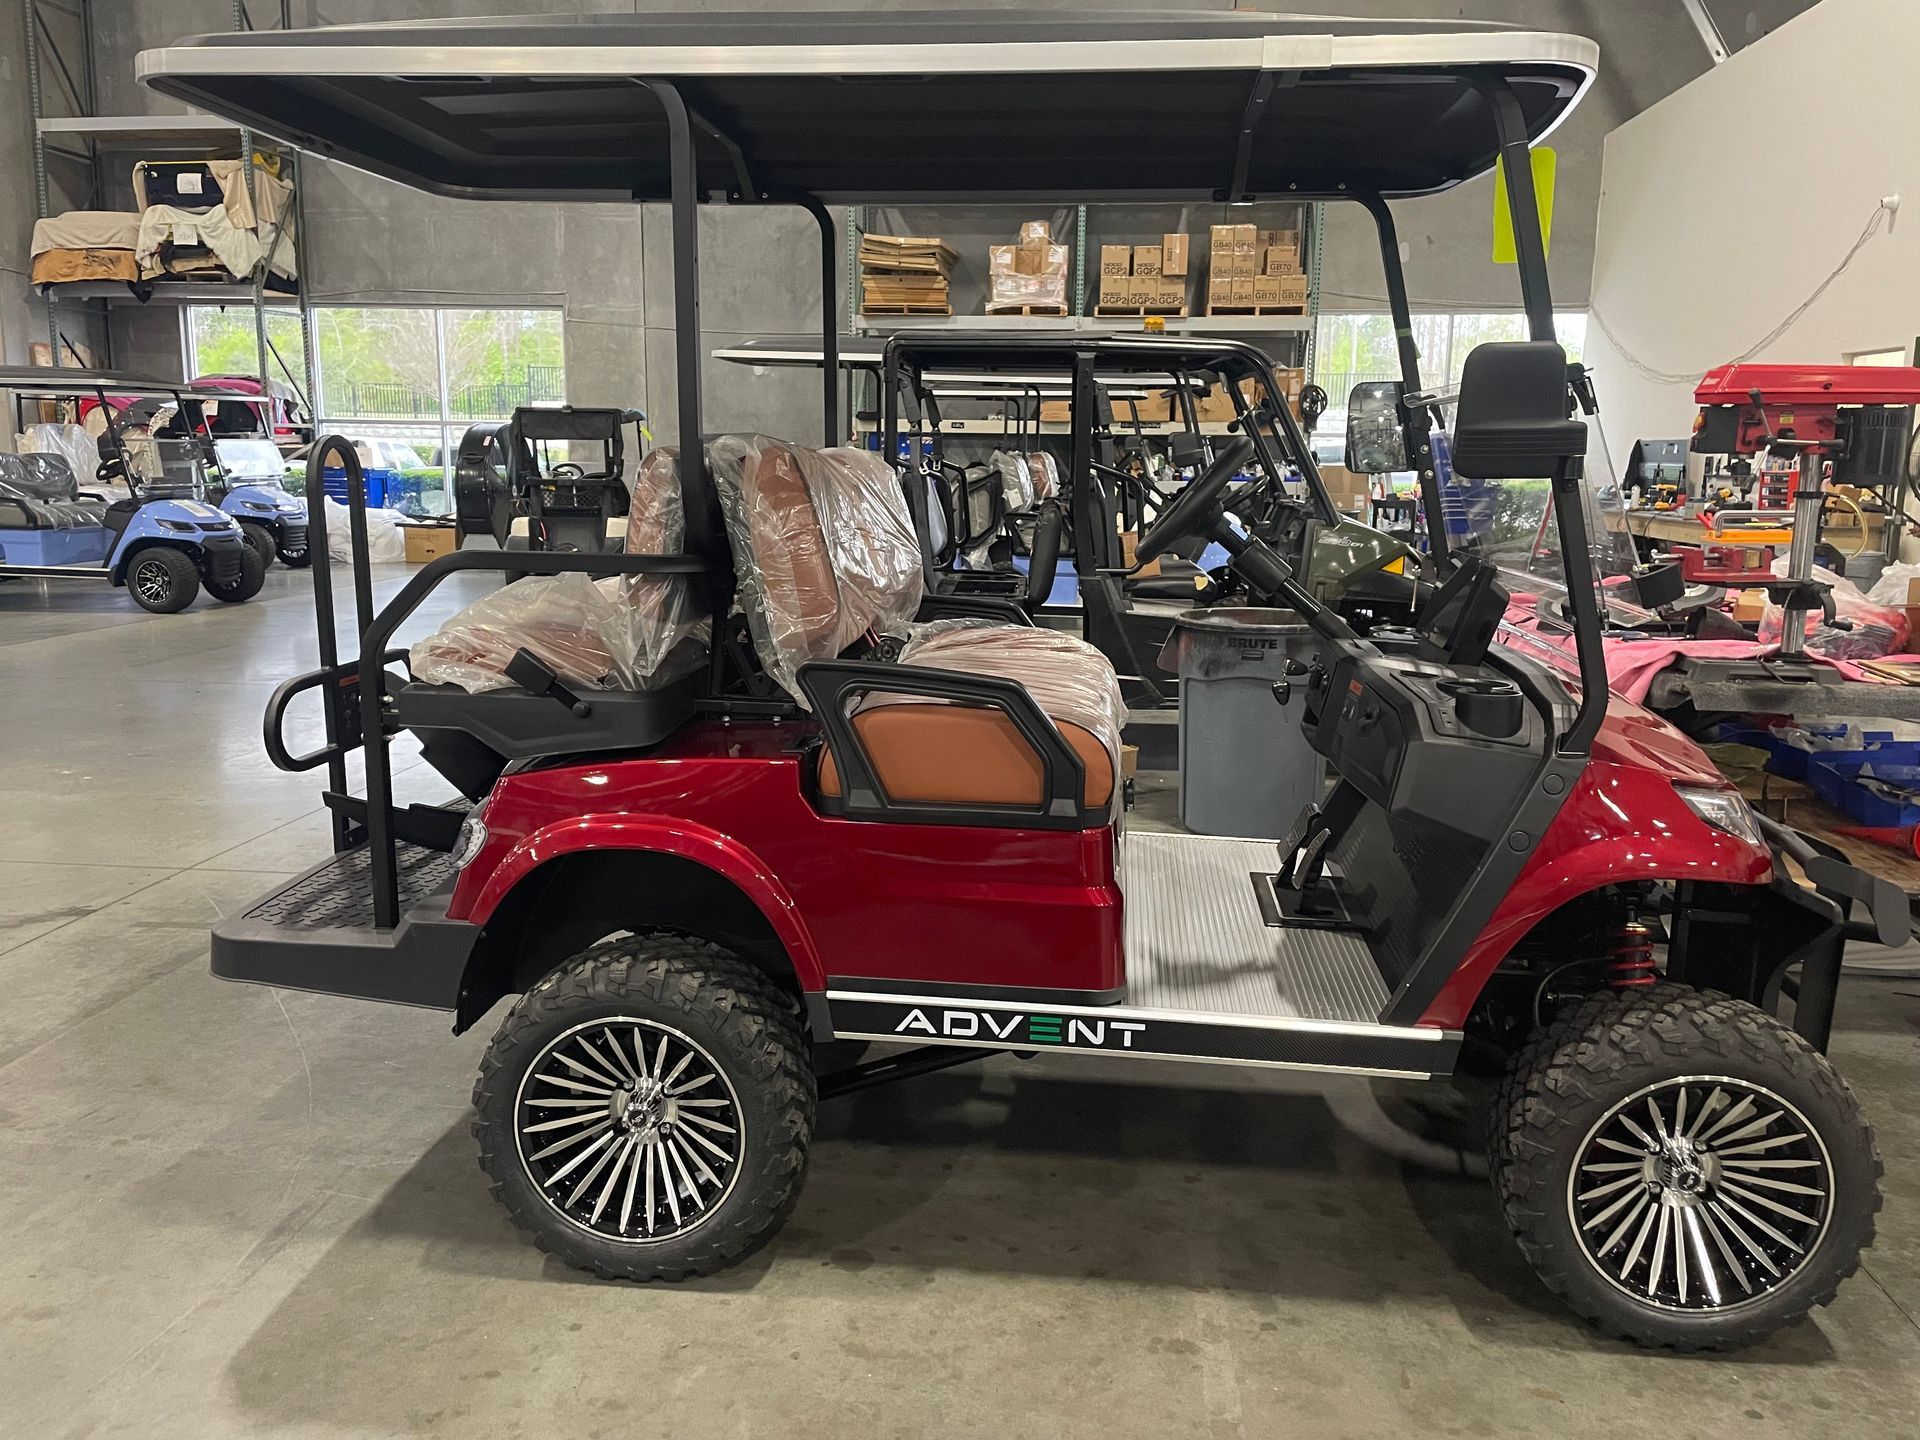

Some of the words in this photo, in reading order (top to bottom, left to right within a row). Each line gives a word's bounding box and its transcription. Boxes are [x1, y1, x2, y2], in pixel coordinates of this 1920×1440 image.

[1104, 267, 1128, 275] GCP2
[1136, 267, 1161, 275] GCP2
[1270, 263, 1292, 271] GB70
[1255, 292, 1277, 300] GB70
[1281, 291, 1304, 299] GB70
[1102, 296, 1127, 304] GCP2
[1130, 297, 1156, 305] GCP2
[1159, 296, 1184, 304] GCP2
[1227, 637, 1278, 649] BRUTE
[894, 1008, 1147, 1047] ADVENT
